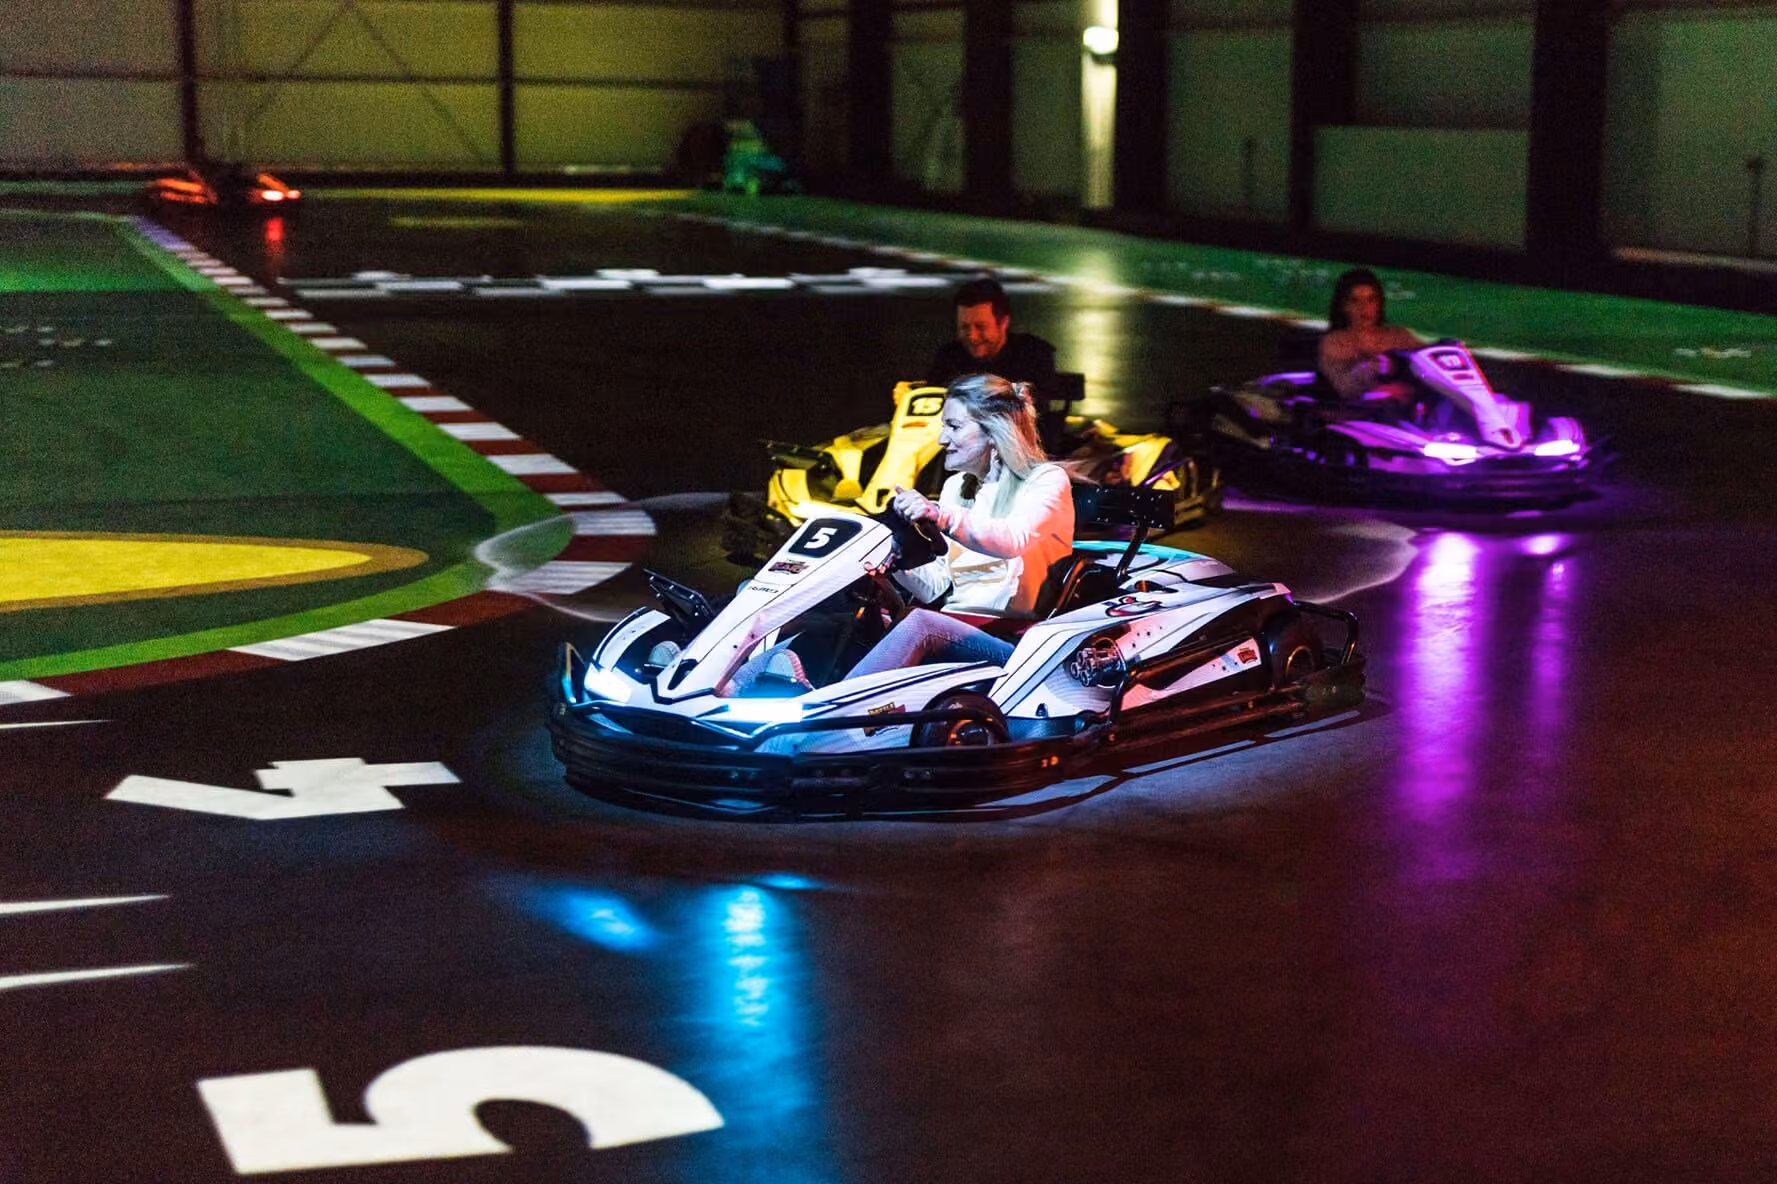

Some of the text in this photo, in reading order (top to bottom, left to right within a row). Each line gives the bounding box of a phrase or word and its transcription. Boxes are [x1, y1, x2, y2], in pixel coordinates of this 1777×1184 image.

[804, 527, 838, 549] 5
[106, 757, 460, 820] 4
[198, 1045, 723, 1173] 5
